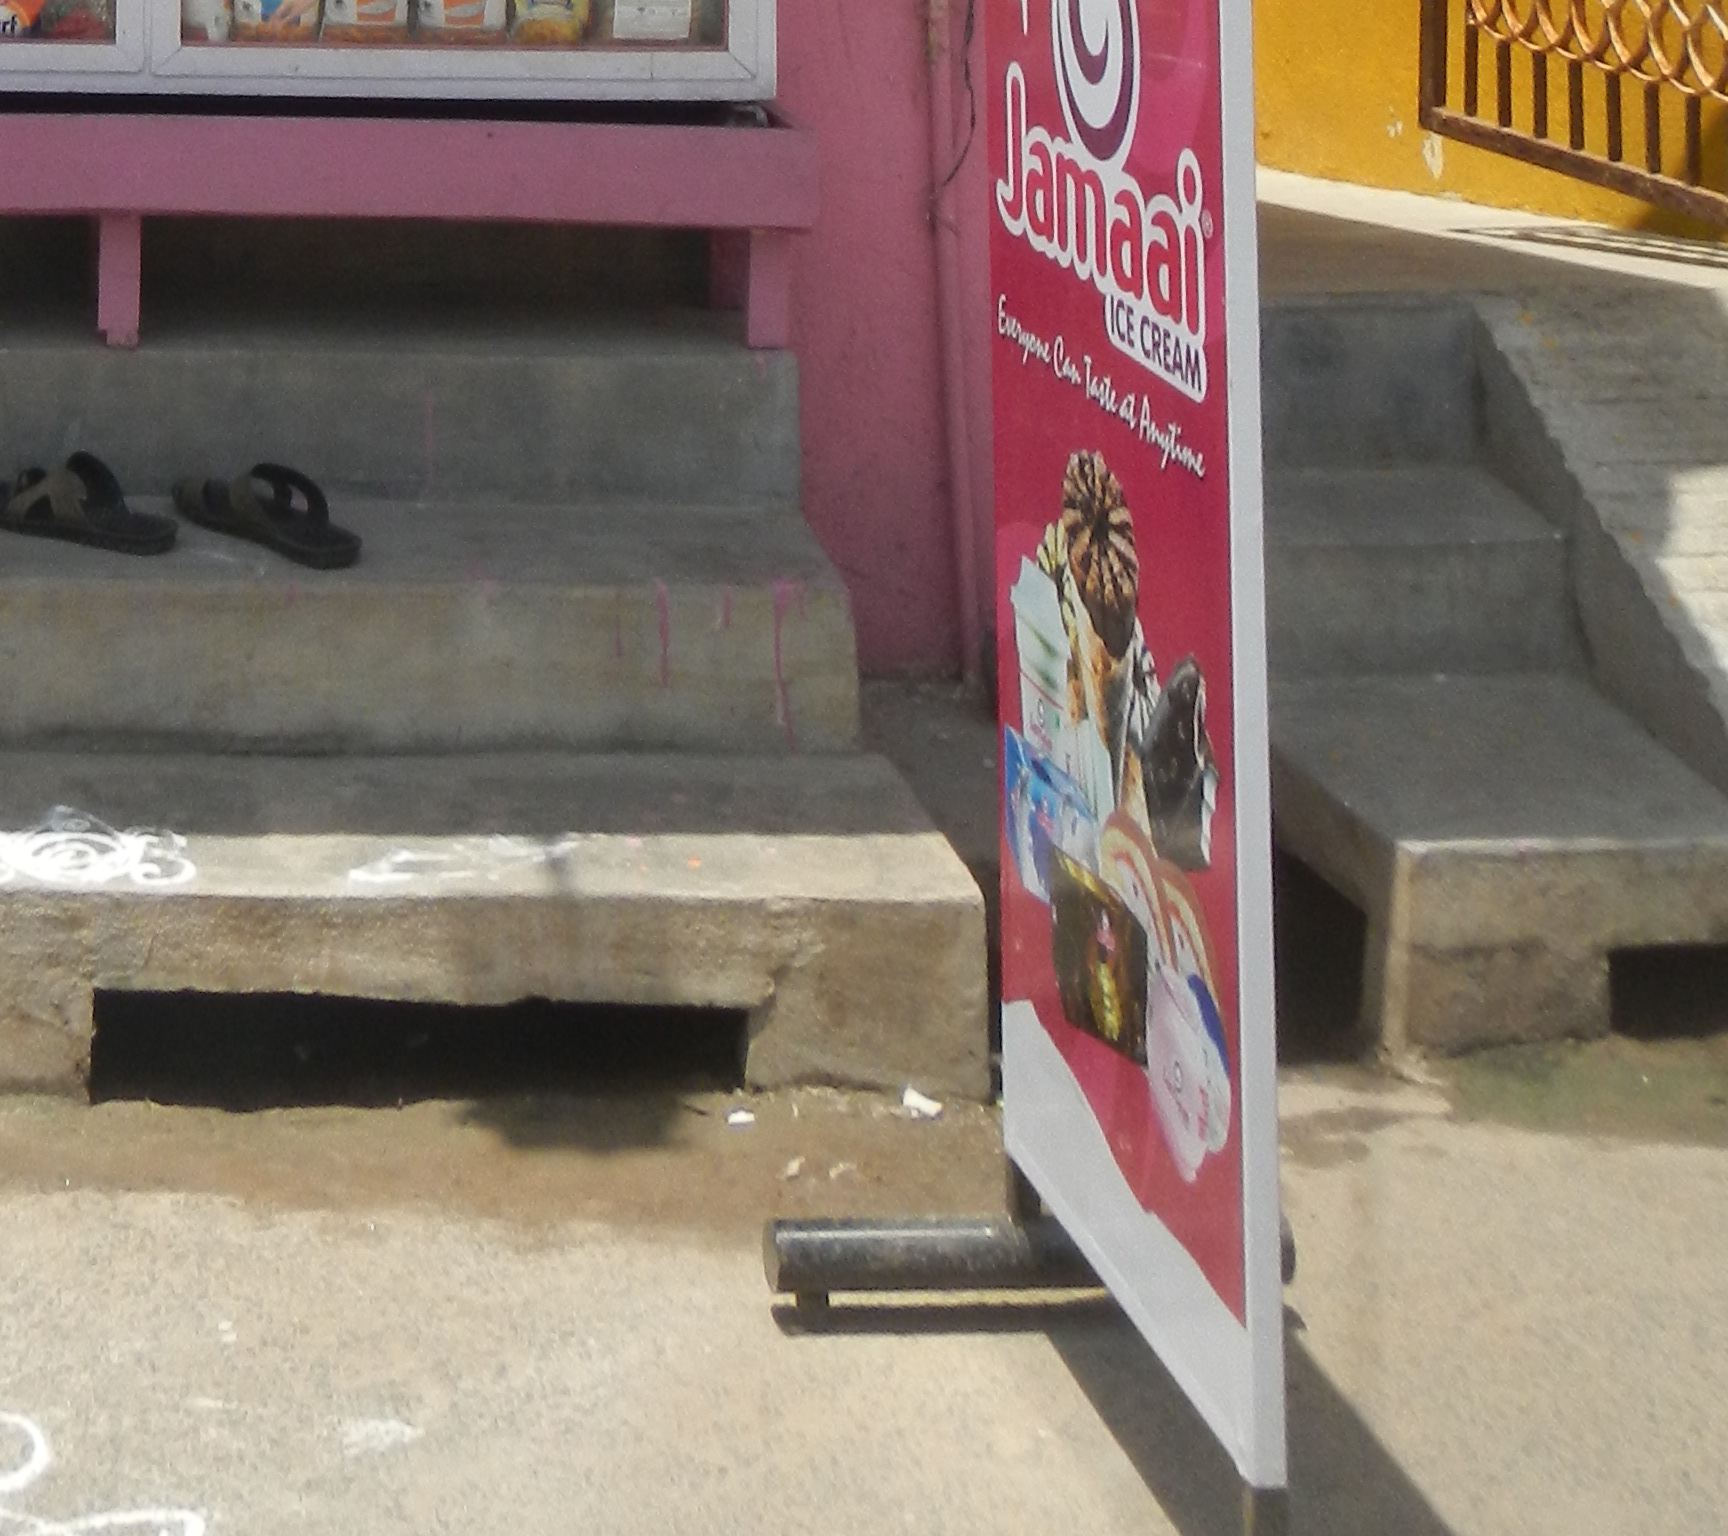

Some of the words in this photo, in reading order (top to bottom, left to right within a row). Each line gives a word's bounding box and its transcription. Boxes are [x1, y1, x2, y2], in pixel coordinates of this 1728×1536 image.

[997, 63, 1205, 338] Jamaai
[997, 294, 1052, 365] Everyone
[1052, 335, 1082, 386] Can
[1082, 355, 1119, 416] Taste
[1119, 392, 1136, 430] at
[1138, 394, 1207, 479] Anytime
[1110, 295, 1135, 346] ICE
[1141, 314, 1203, 394] CREAM
